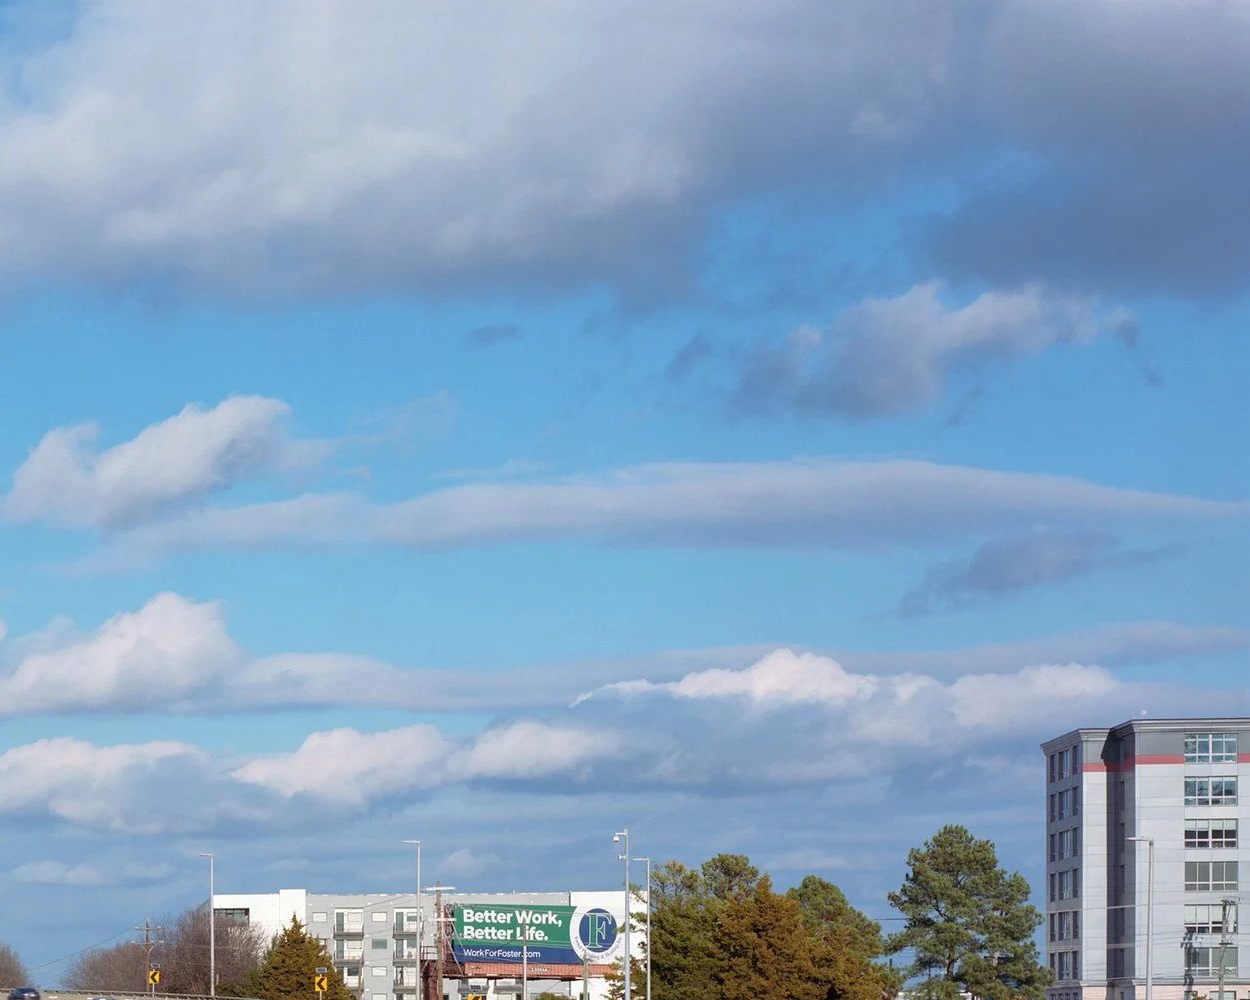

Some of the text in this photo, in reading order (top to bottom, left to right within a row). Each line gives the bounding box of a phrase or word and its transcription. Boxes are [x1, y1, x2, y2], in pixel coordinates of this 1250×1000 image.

[463, 909, 562, 927] Better Work,
[463, 925, 549, 941] Better Life.
[585, 912, 612, 949] F
[463, 948, 541, 958] WorkForFoster.com
